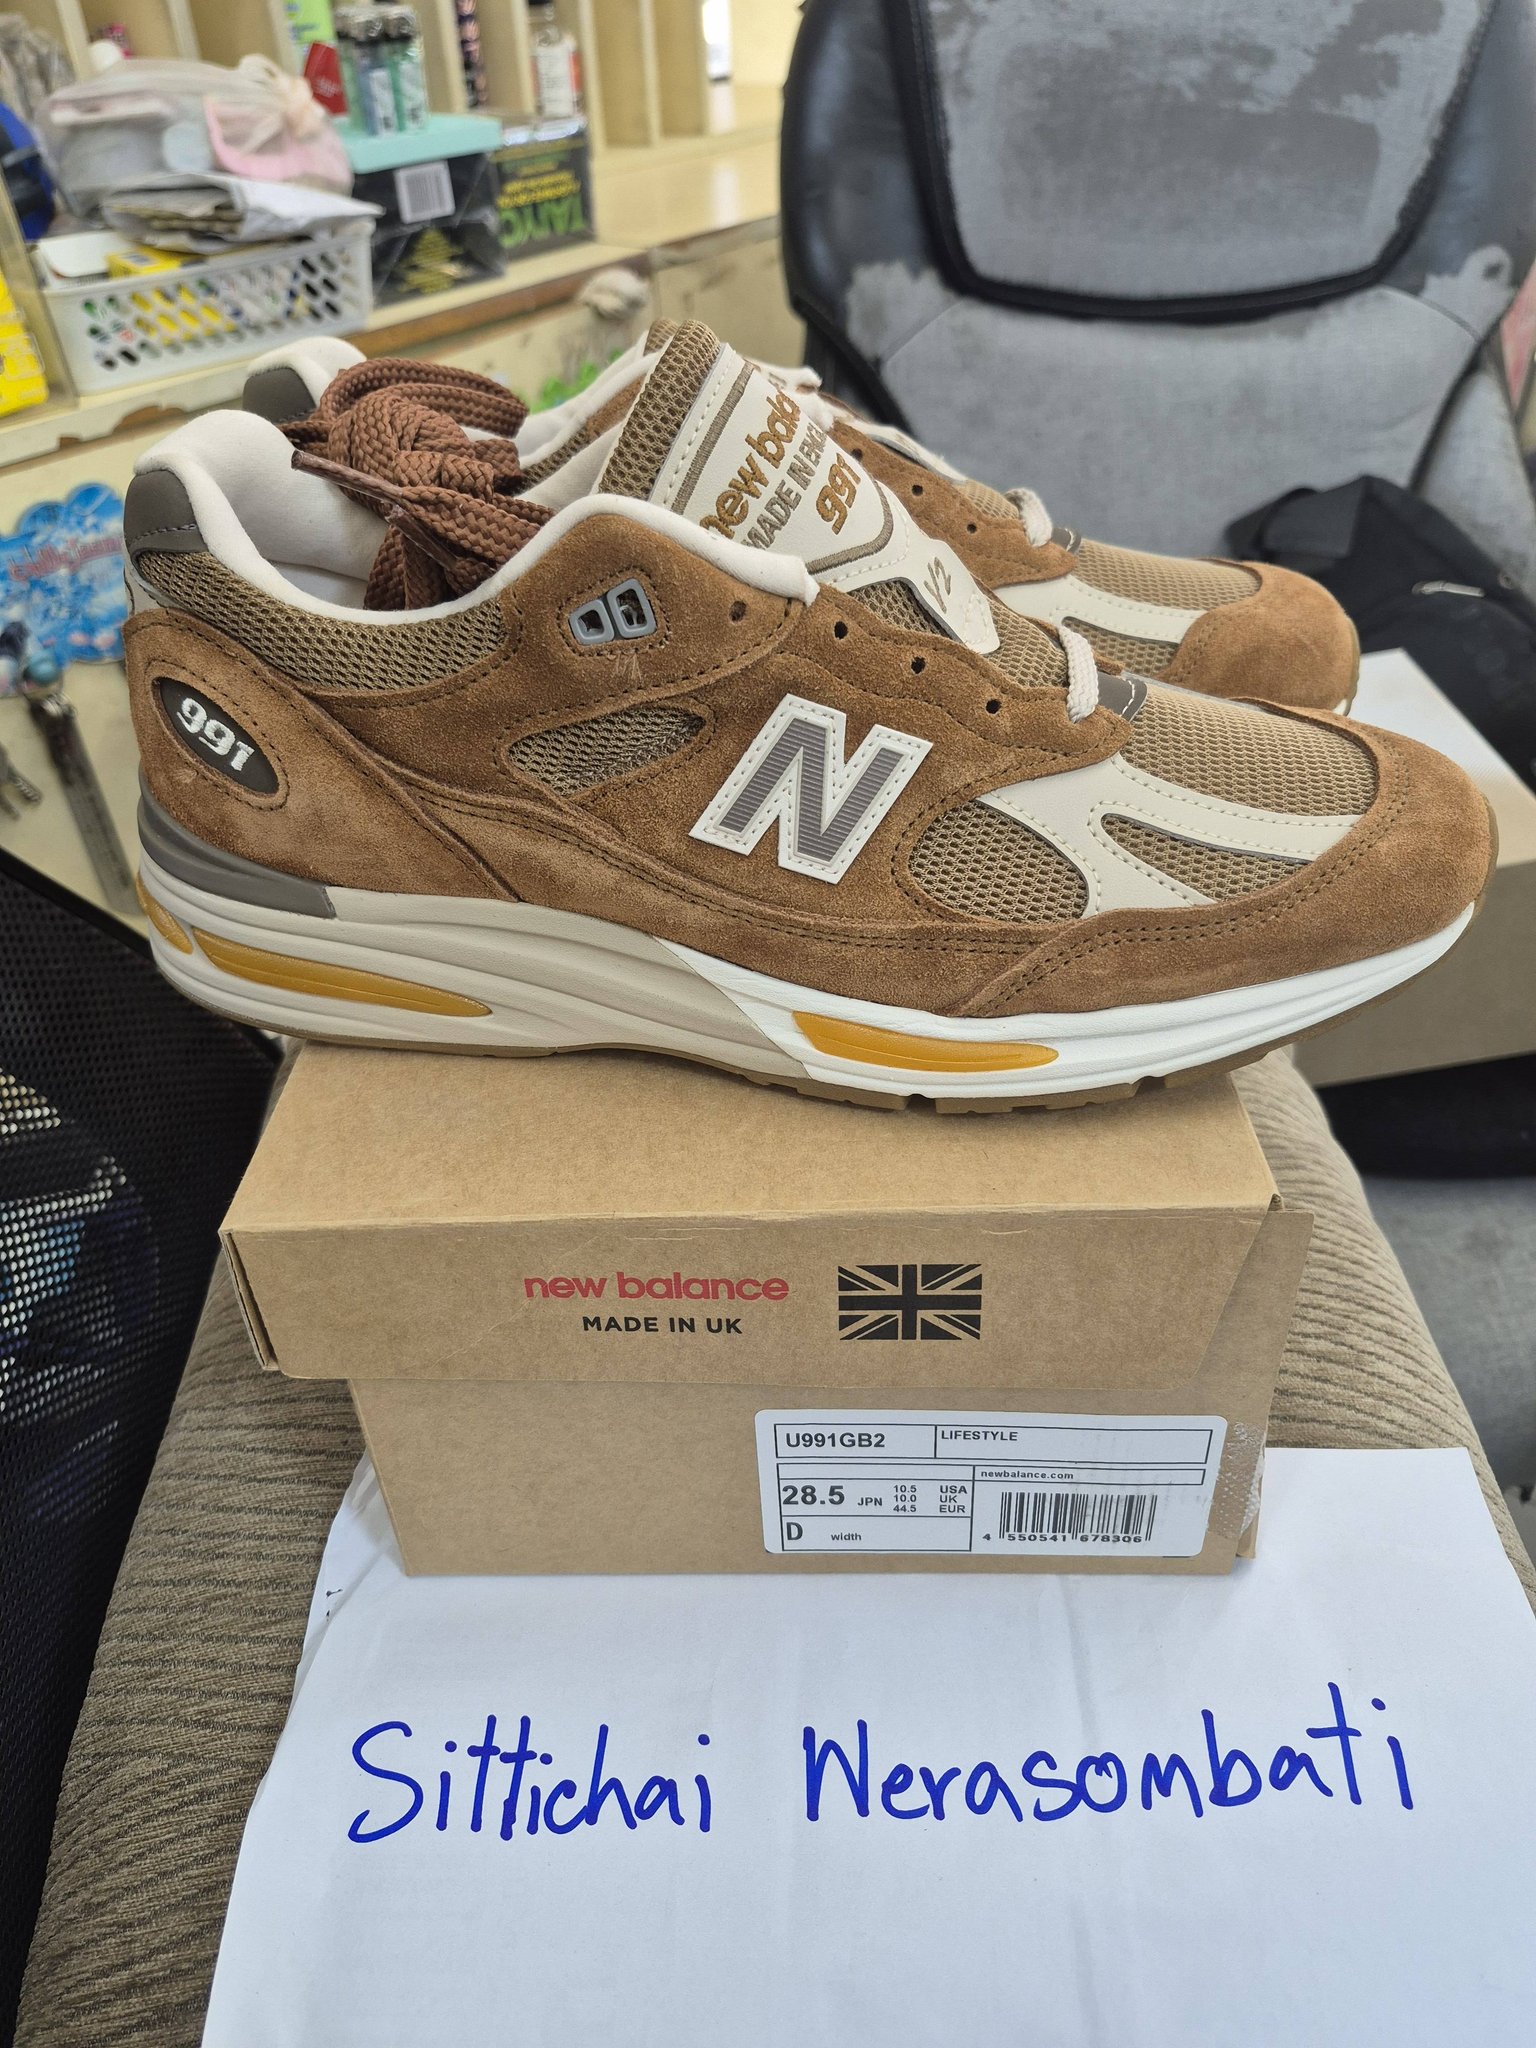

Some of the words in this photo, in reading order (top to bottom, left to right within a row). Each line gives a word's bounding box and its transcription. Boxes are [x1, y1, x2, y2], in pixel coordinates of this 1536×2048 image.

[699, 453, 770, 540] new
[744, 387, 801, 470] bala
[742, 479, 802, 549] MADE
[786, 454, 816, 491] IN
[815, 452, 861, 535] 991
[176, 698, 255, 771] 991
[688, 693, 933, 884] N
[524, 1275, 607, 1298] new
[616, 1271, 789, 1301] balance
[582, 1316, 659, 1332] MADE
[668, 1317, 696, 1333] IN
[706, 1317, 743, 1335] UK
[785, 1432, 886, 1448] U991GB2
[941, 1430, 1018, 1442] LIFESTYLE
[980, 1470, 1074, 1480] newbalance.com
[782, 1484, 846, 1505] 28.5
[857, 1496, 883, 1507] JPN
[893, 1484, 917, 1493] 10.5
[939, 1485, 968, 1494] USA
[893, 1494, 917, 1503] 10.0
[939, 1494, 958, 1503] UK
[892, 1504, 917, 1513] 44.5
[939, 1504, 966, 1514] EUR
[786, 1521, 804, 1541] D
[830, 1532, 862, 1541] width
[982, 1533, 991, 1541] 4
[1007, 1533, 1067, 1542] 550541
[1079, 1534, 1142, 1543] 678306
[347, 1714, 712, 1844] Sittichai
